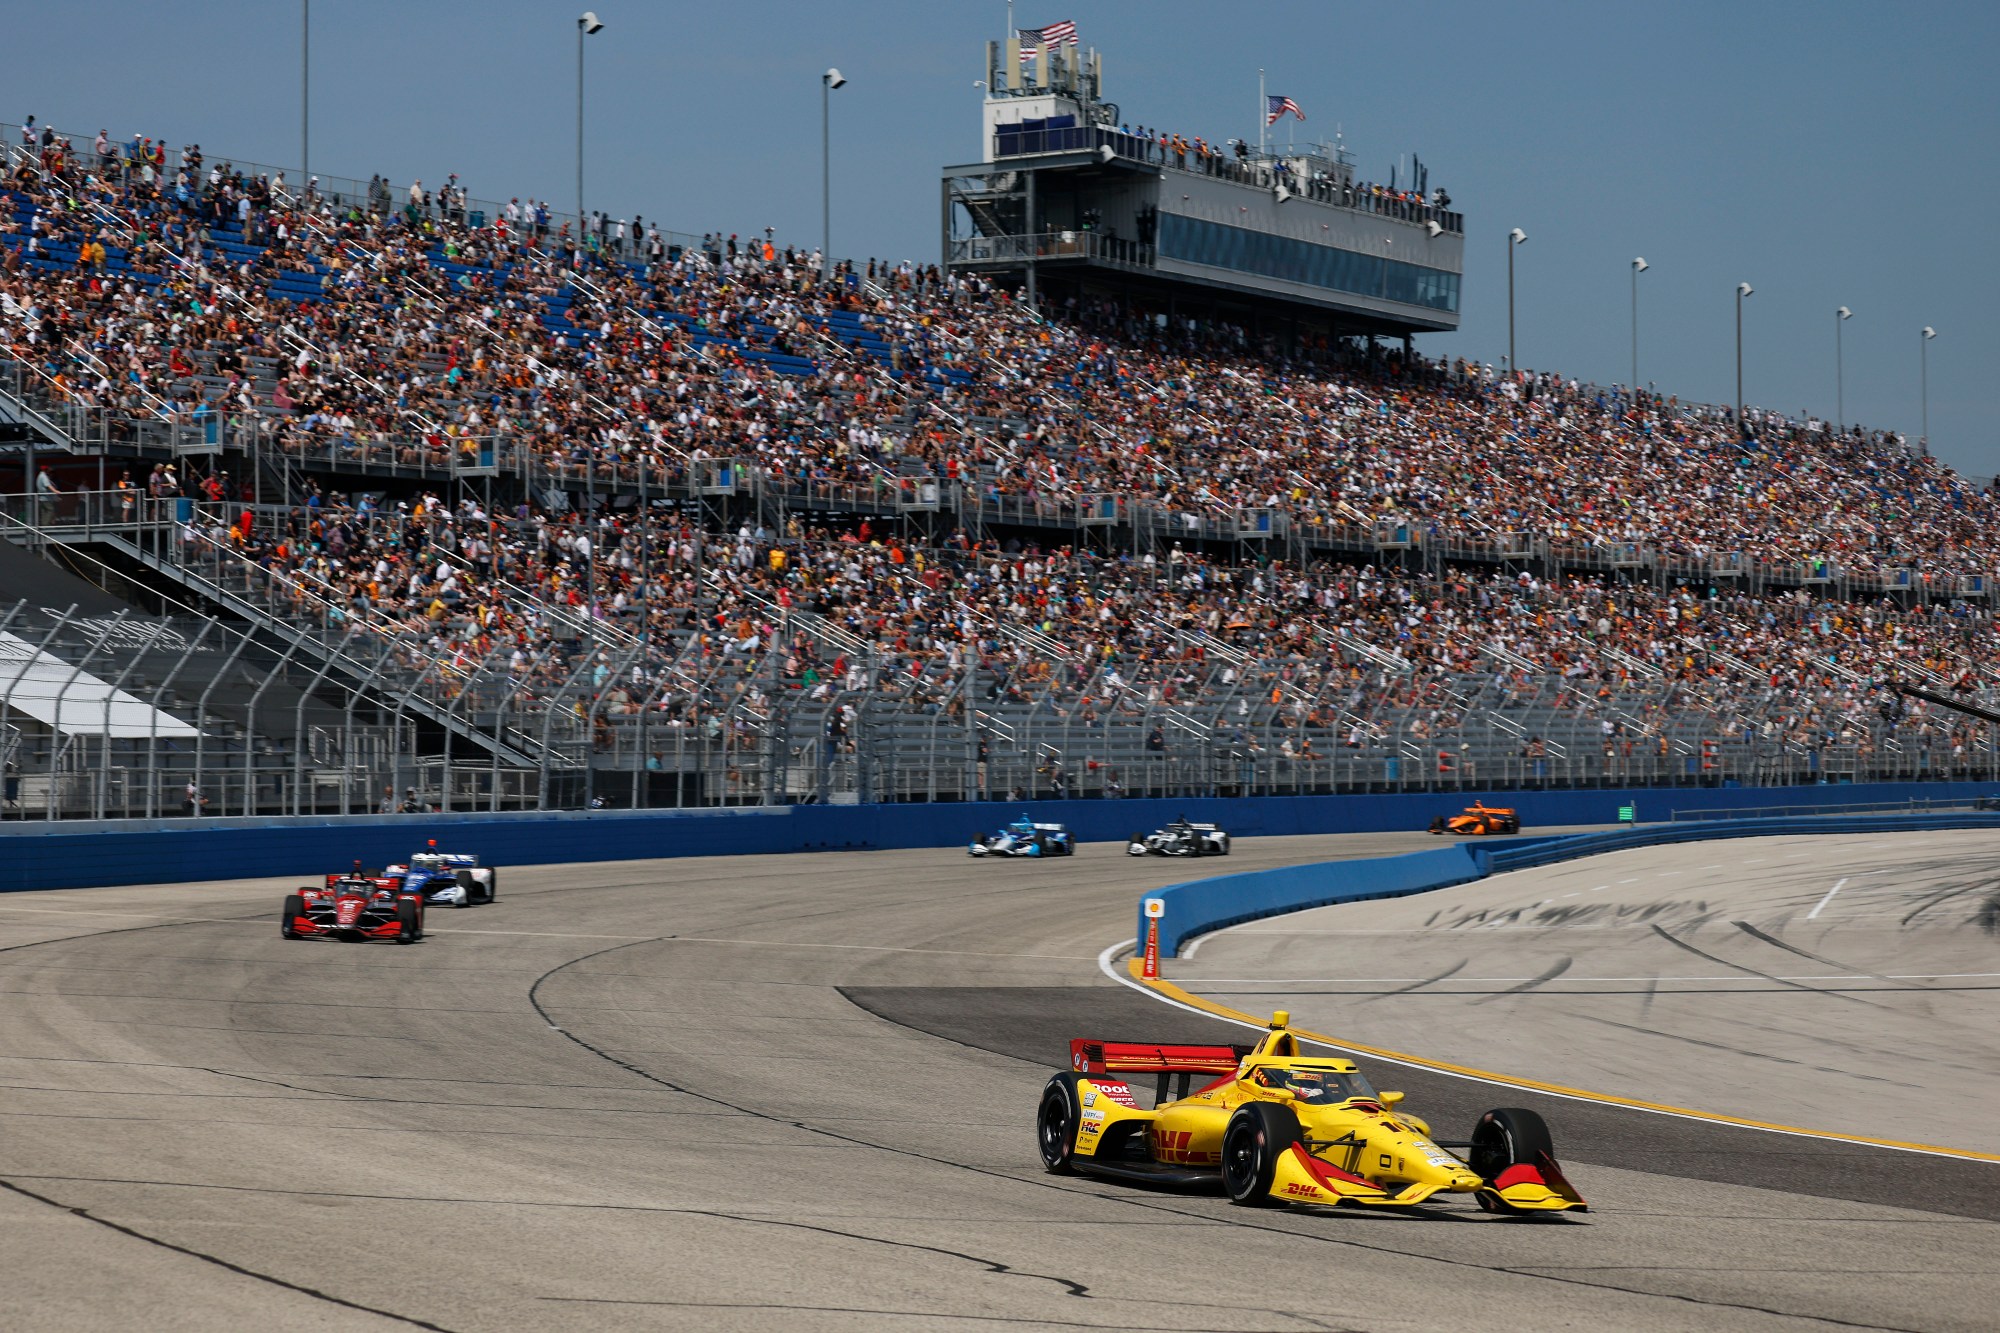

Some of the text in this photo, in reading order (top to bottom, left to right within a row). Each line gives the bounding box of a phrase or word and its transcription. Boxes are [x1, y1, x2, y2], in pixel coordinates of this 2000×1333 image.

[1081, 1121, 1101, 1134] HRC
[1152, 1129, 1209, 1163] DHL
[1287, 1183, 1318, 1198] DHL
